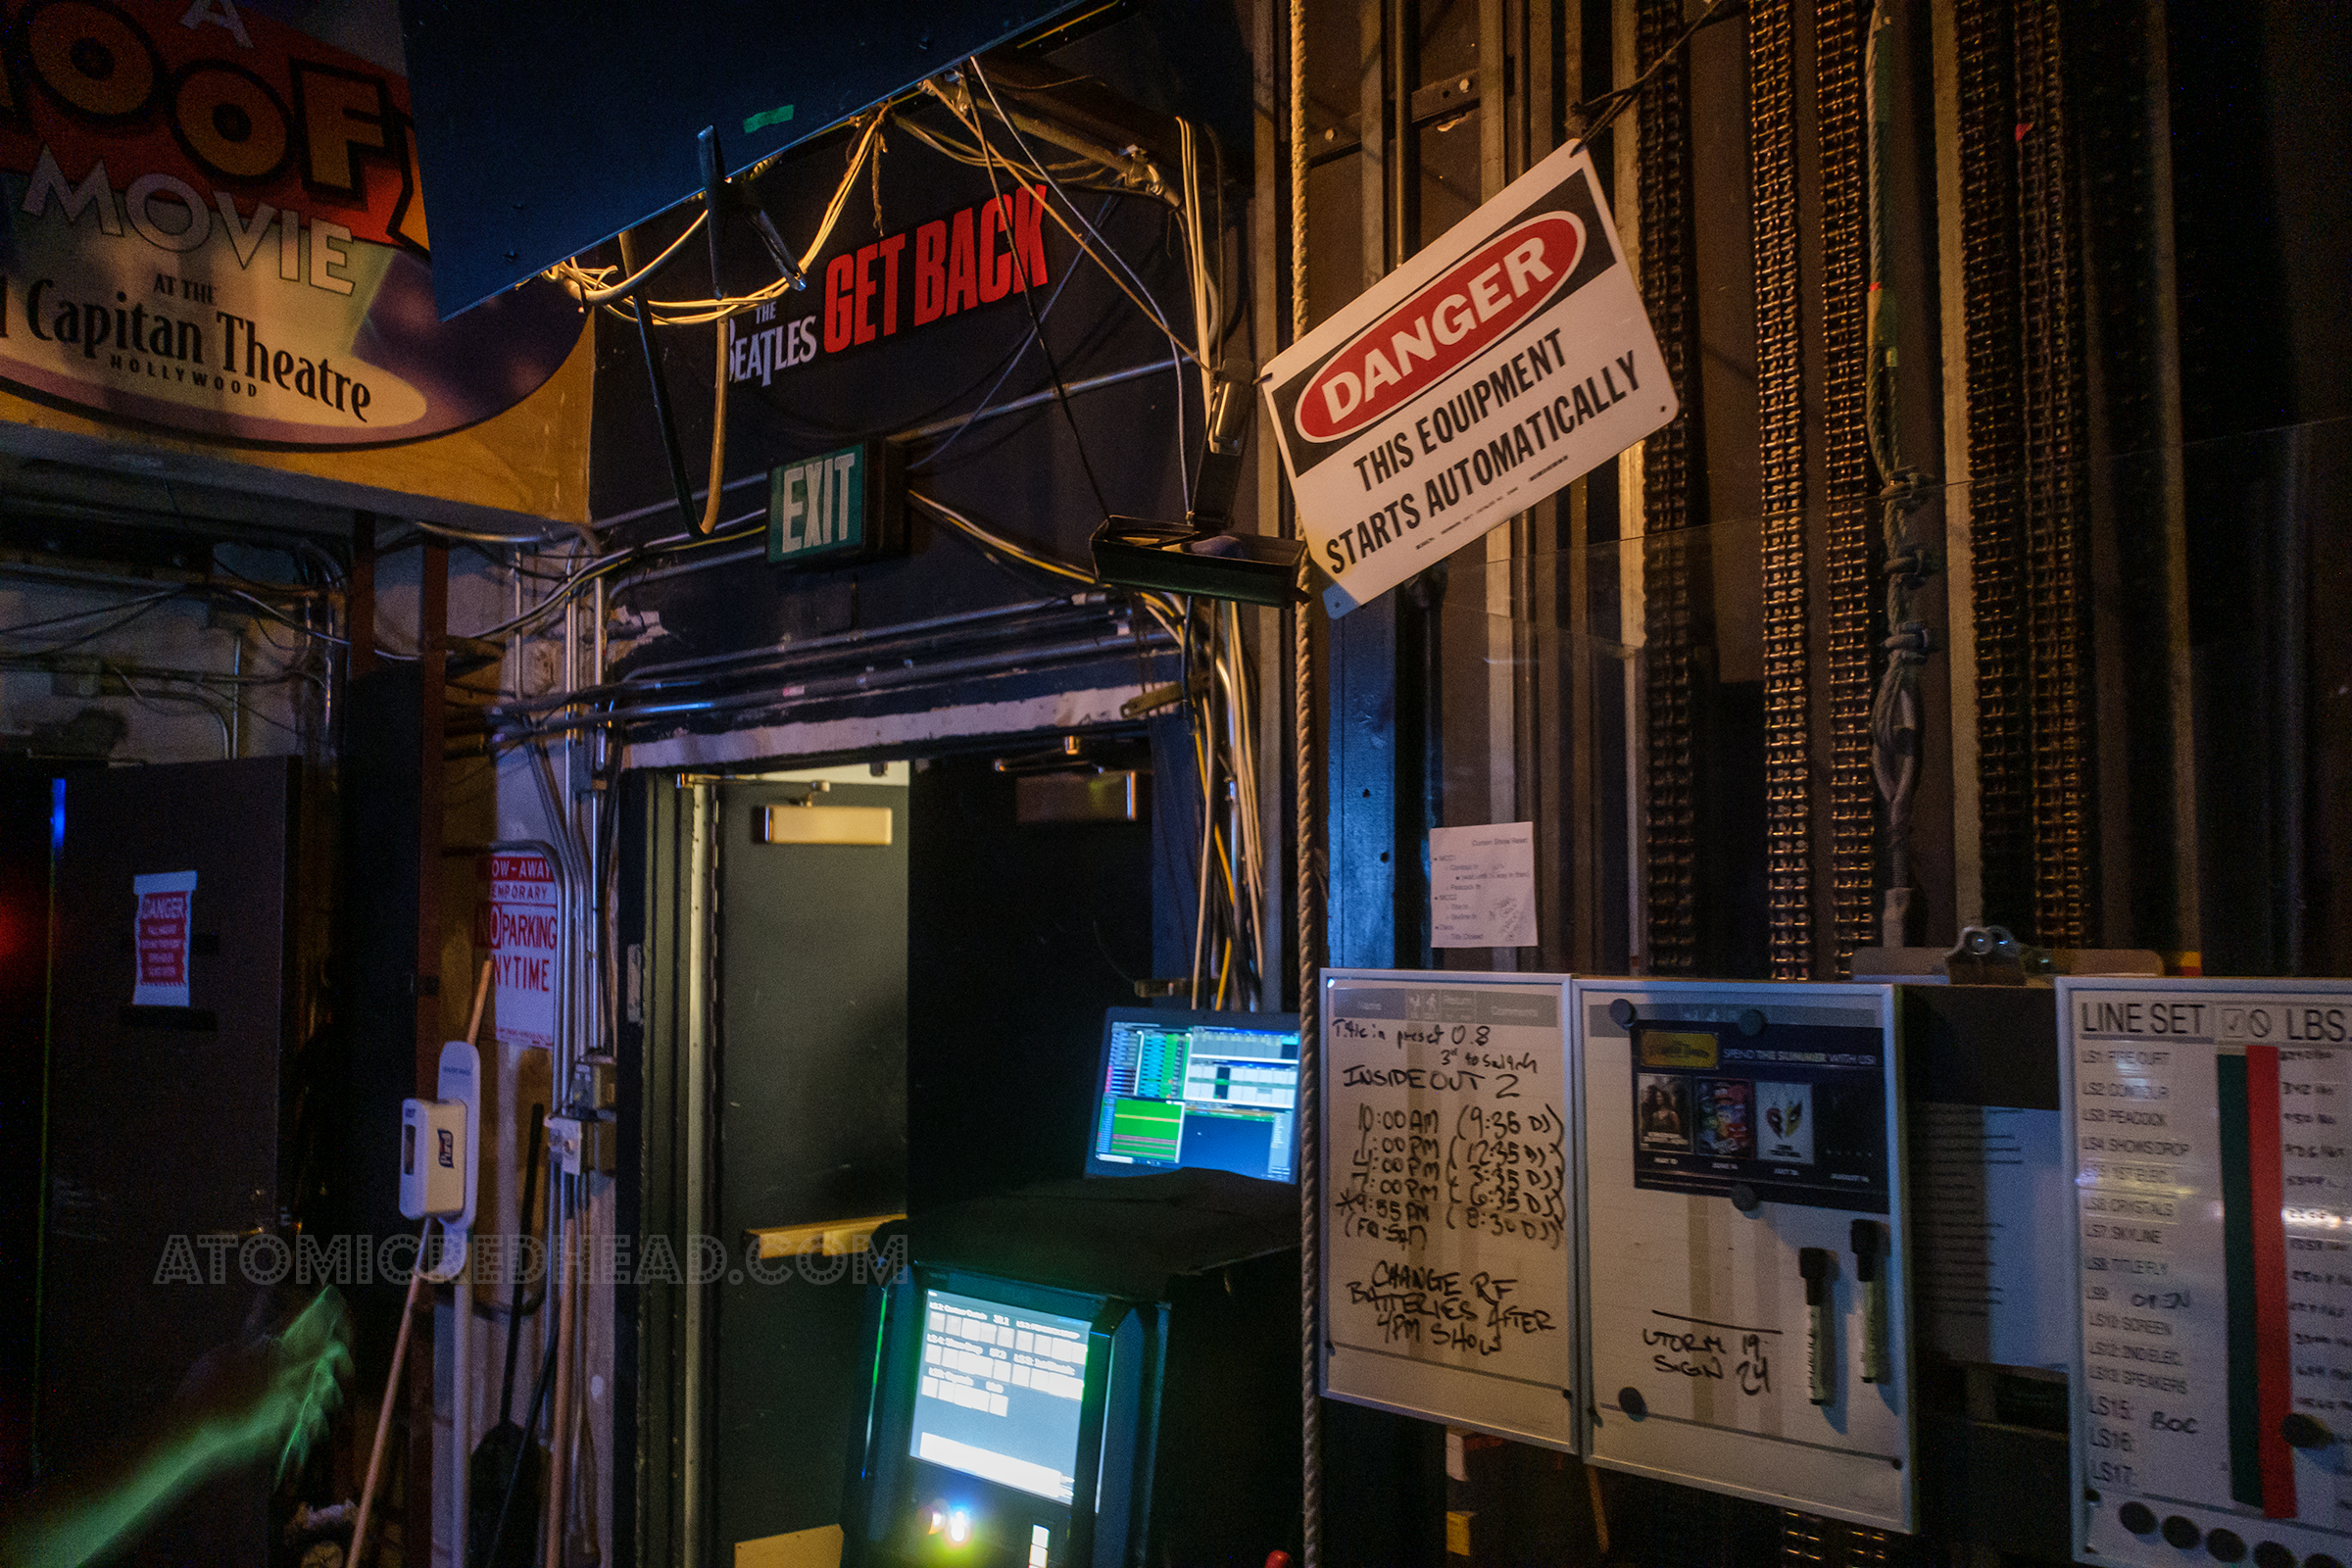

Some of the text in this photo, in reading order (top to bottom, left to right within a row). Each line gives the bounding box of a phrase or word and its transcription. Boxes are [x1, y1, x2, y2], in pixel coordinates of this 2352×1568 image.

[180, 0, 254, 49] A
[22, 143, 357, 297] MOVIE
[153, 273, 218, 306] AT THE
[823, 183, 1049, 355] GET BACK
[756, 301, 777, 324] THE
[1321, 236, 1554, 424] DANGER
[26, 279, 204, 365] Capitan
[217, 311, 371, 422] Theatre
[110, 355, 257, 397] HOLLYWOOD
[1352, 327, 1566, 492] THIS EQUIPMENT
[1326, 492, 1421, 574] STARTS
[1424, 350, 1642, 519] AUTOMATICALLY
[782, 451, 855, 554] EXIT
[502, 913, 557, 950] PARKING
[492, 954, 550, 992] NYTIME
[2082, 1003, 2205, 1035] LINE SET
[1495, 1073, 1520, 1099] 2
[1372, 1260, 1518, 1304] CHANGE RF
[1346, 1281, 1557, 1335] BATTERIES AFTER
[1430, 1322, 1502, 1356] SHOW
